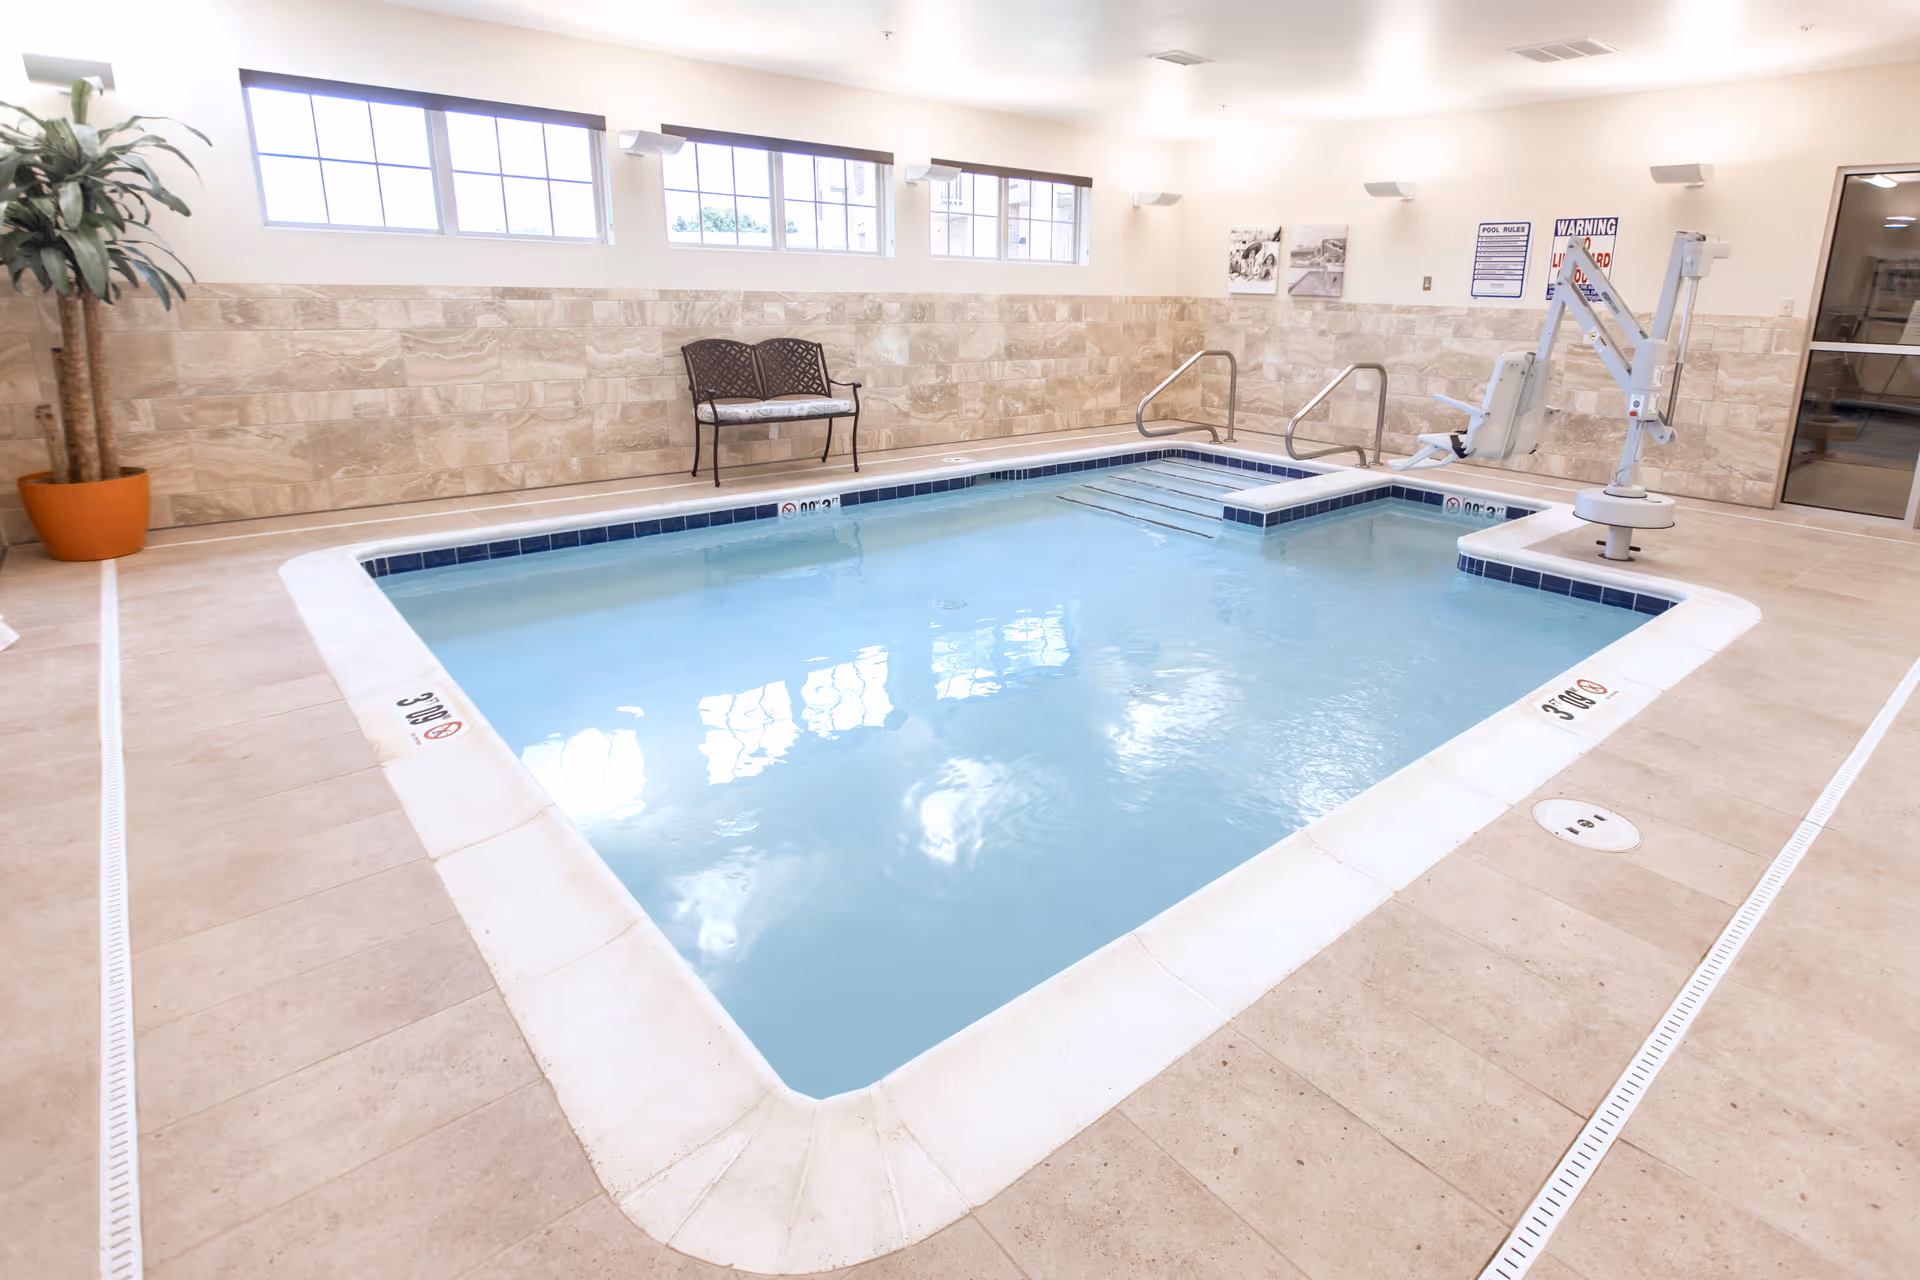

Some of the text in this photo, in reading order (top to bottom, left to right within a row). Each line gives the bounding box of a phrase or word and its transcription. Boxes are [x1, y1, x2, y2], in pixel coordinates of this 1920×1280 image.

[1557, 219, 1616, 235] WARNING
[396, 692, 434, 706] 3
[1541, 704, 1575, 721] 3
